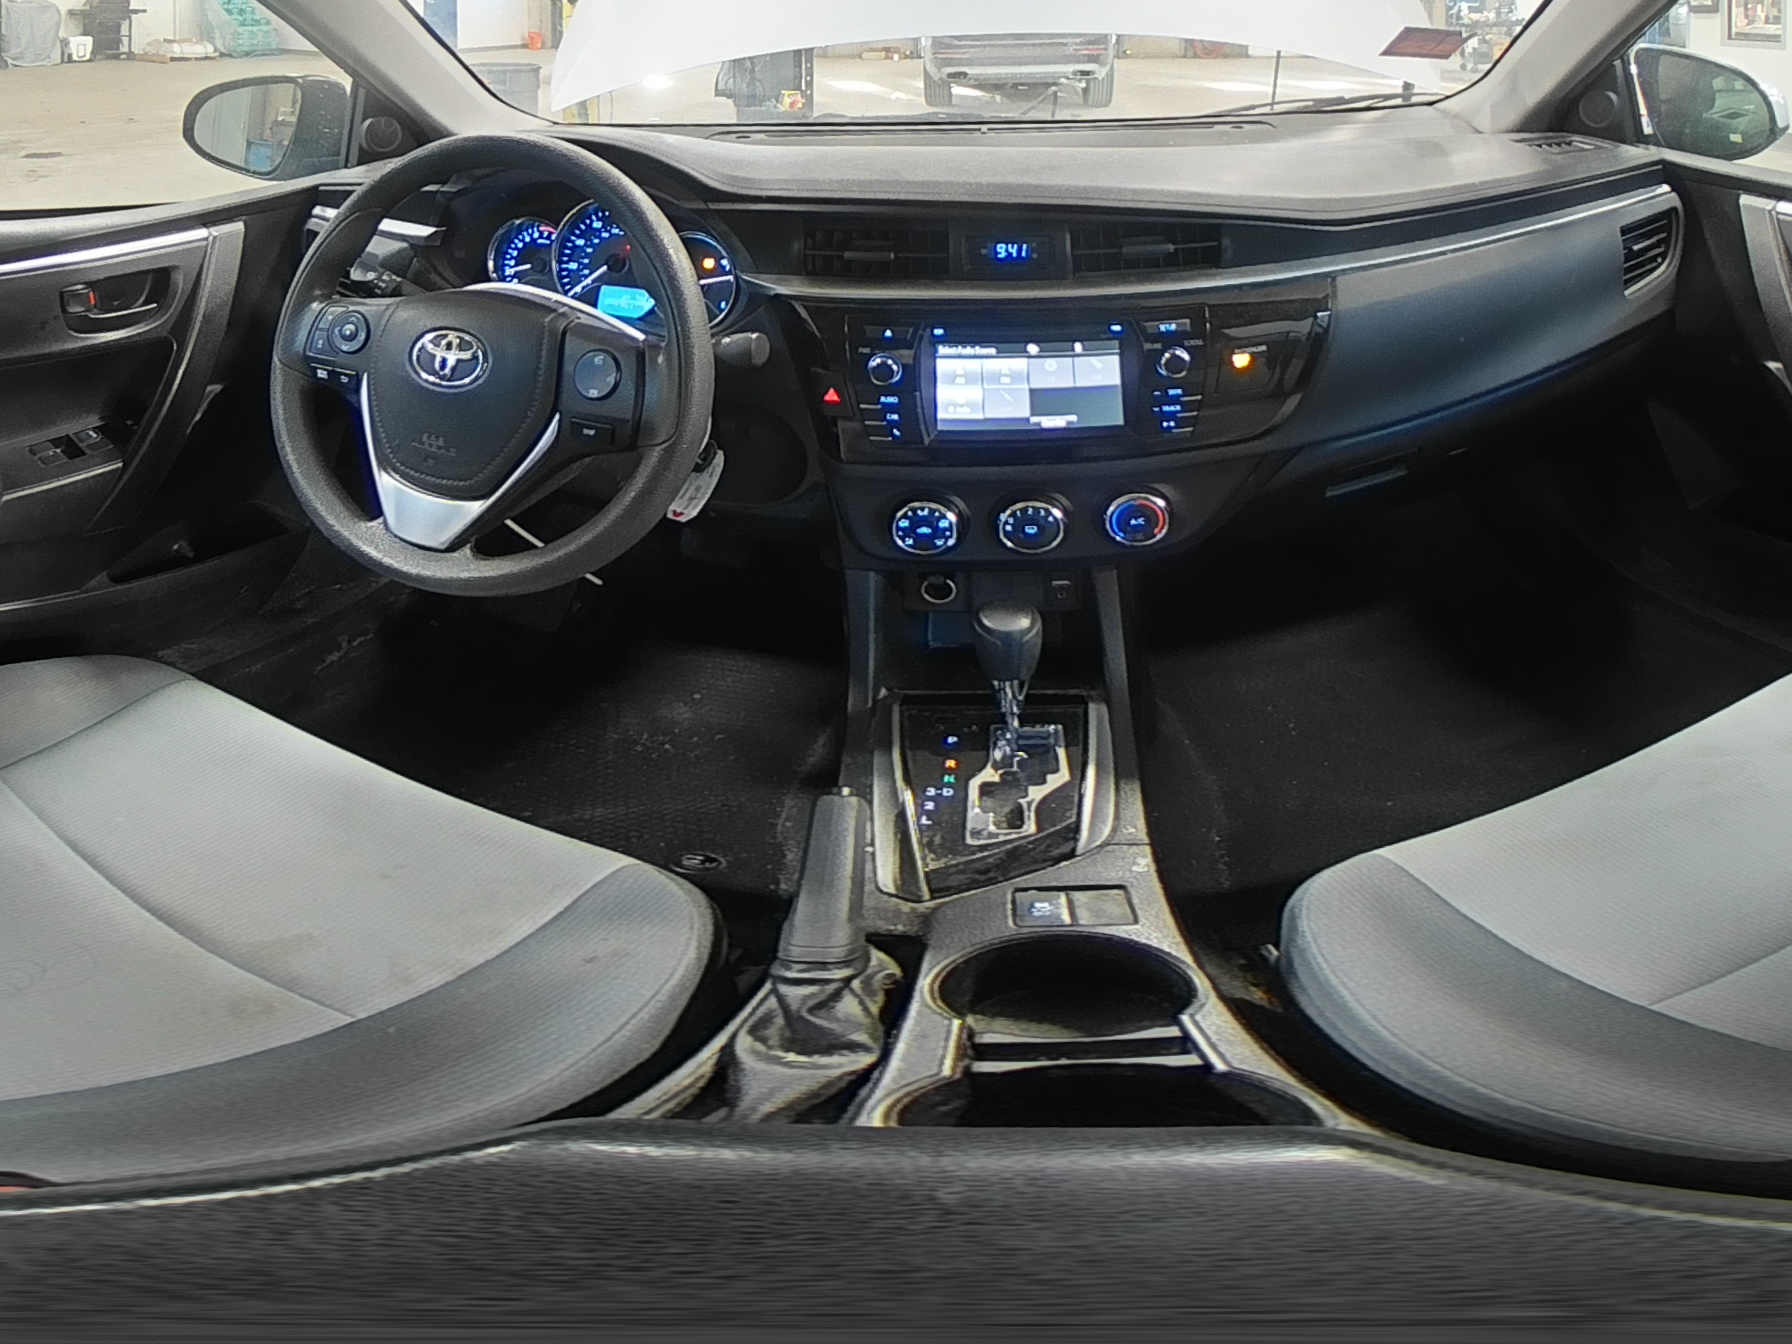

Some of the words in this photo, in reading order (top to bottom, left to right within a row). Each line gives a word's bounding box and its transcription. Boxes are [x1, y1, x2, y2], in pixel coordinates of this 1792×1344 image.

[945, 759, 958, 769] R
[925, 787, 954, 796] 3-D
[923, 801, 935, 810] 2
[920, 815, 933, 825] L
